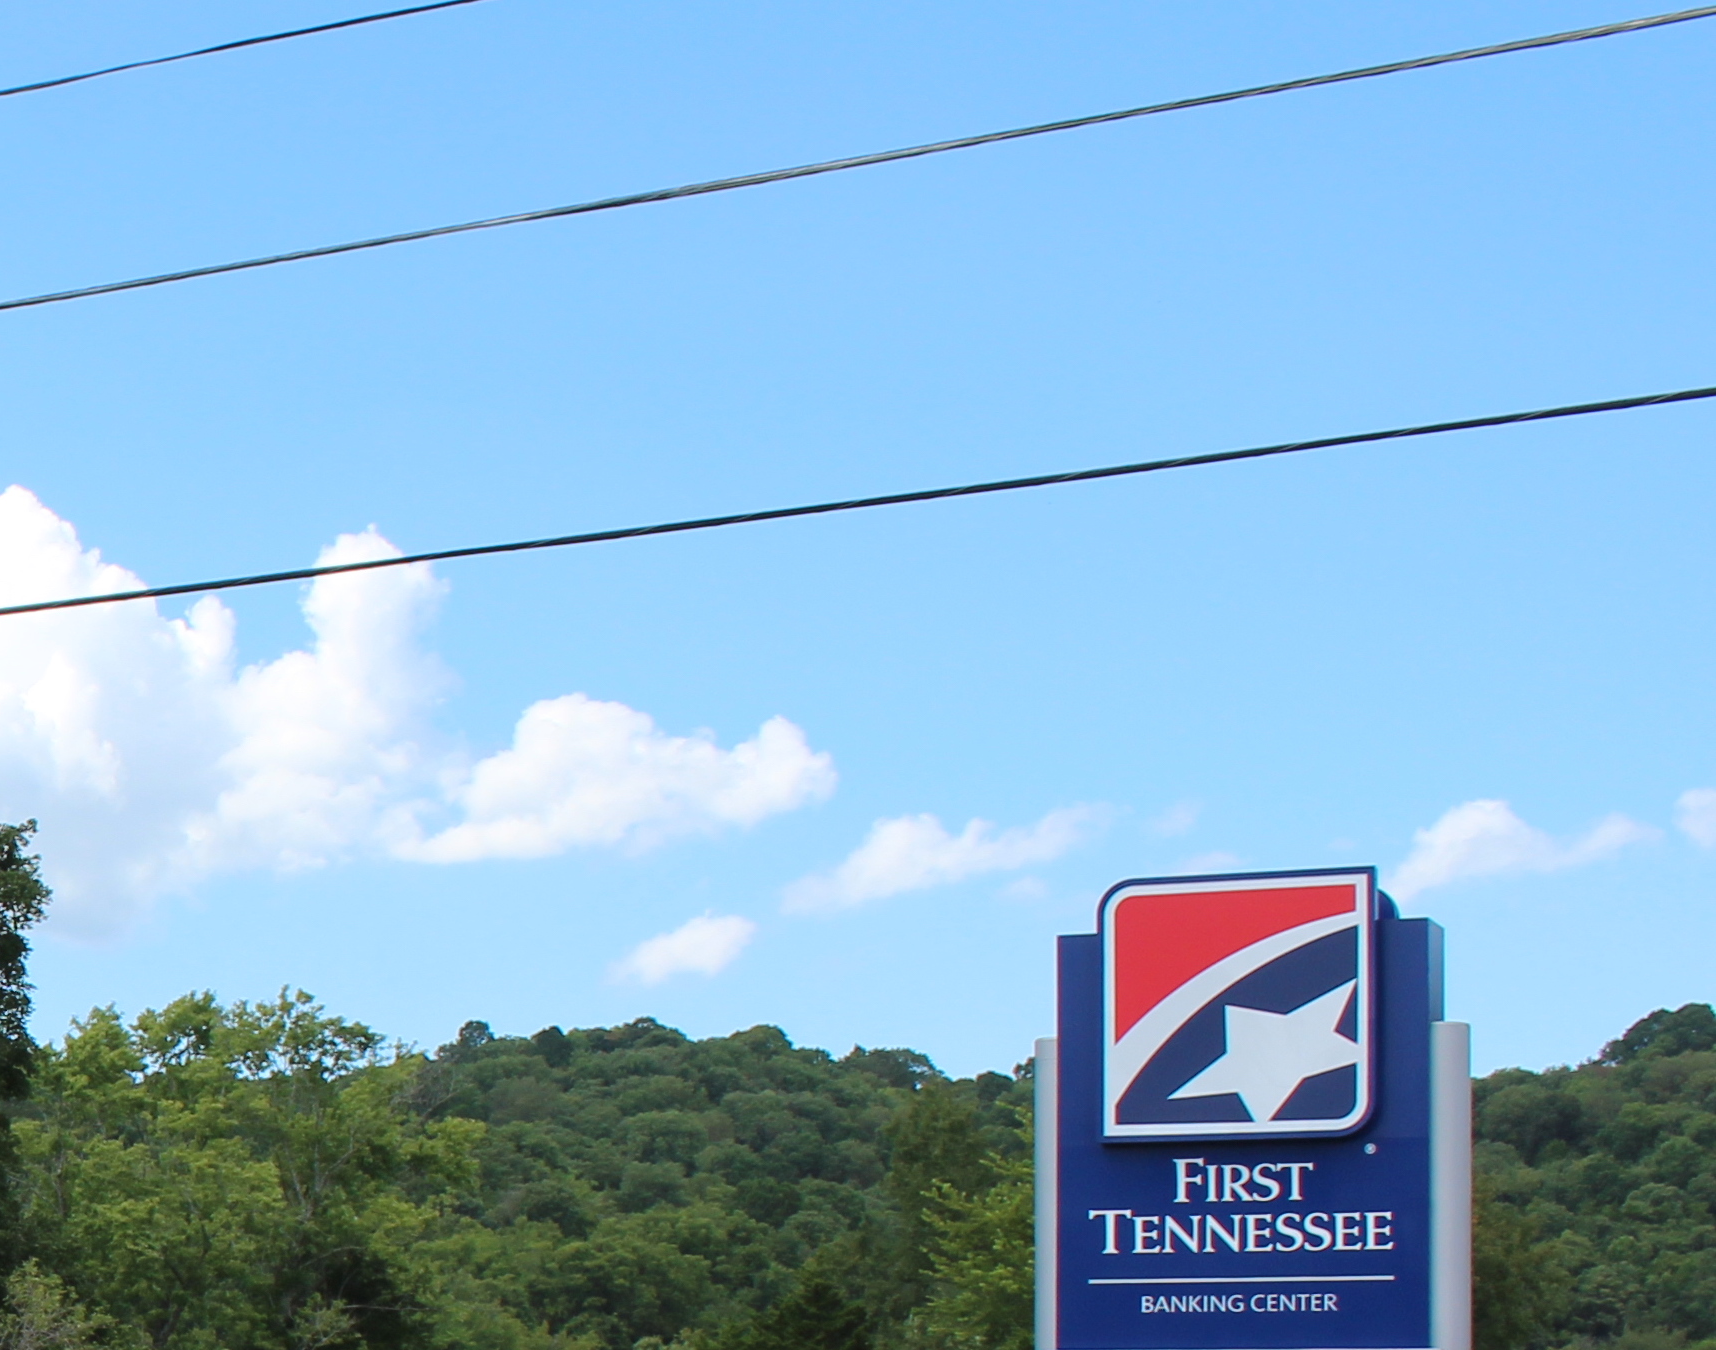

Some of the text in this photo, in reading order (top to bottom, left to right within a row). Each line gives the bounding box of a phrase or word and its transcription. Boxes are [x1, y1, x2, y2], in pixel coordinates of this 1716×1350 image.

[1172, 1157, 1314, 1203] FIRST
[1088, 1209, 1395, 1254] TENNESSEE
[1140, 1292, 1339, 1313] BANKING CENTER
